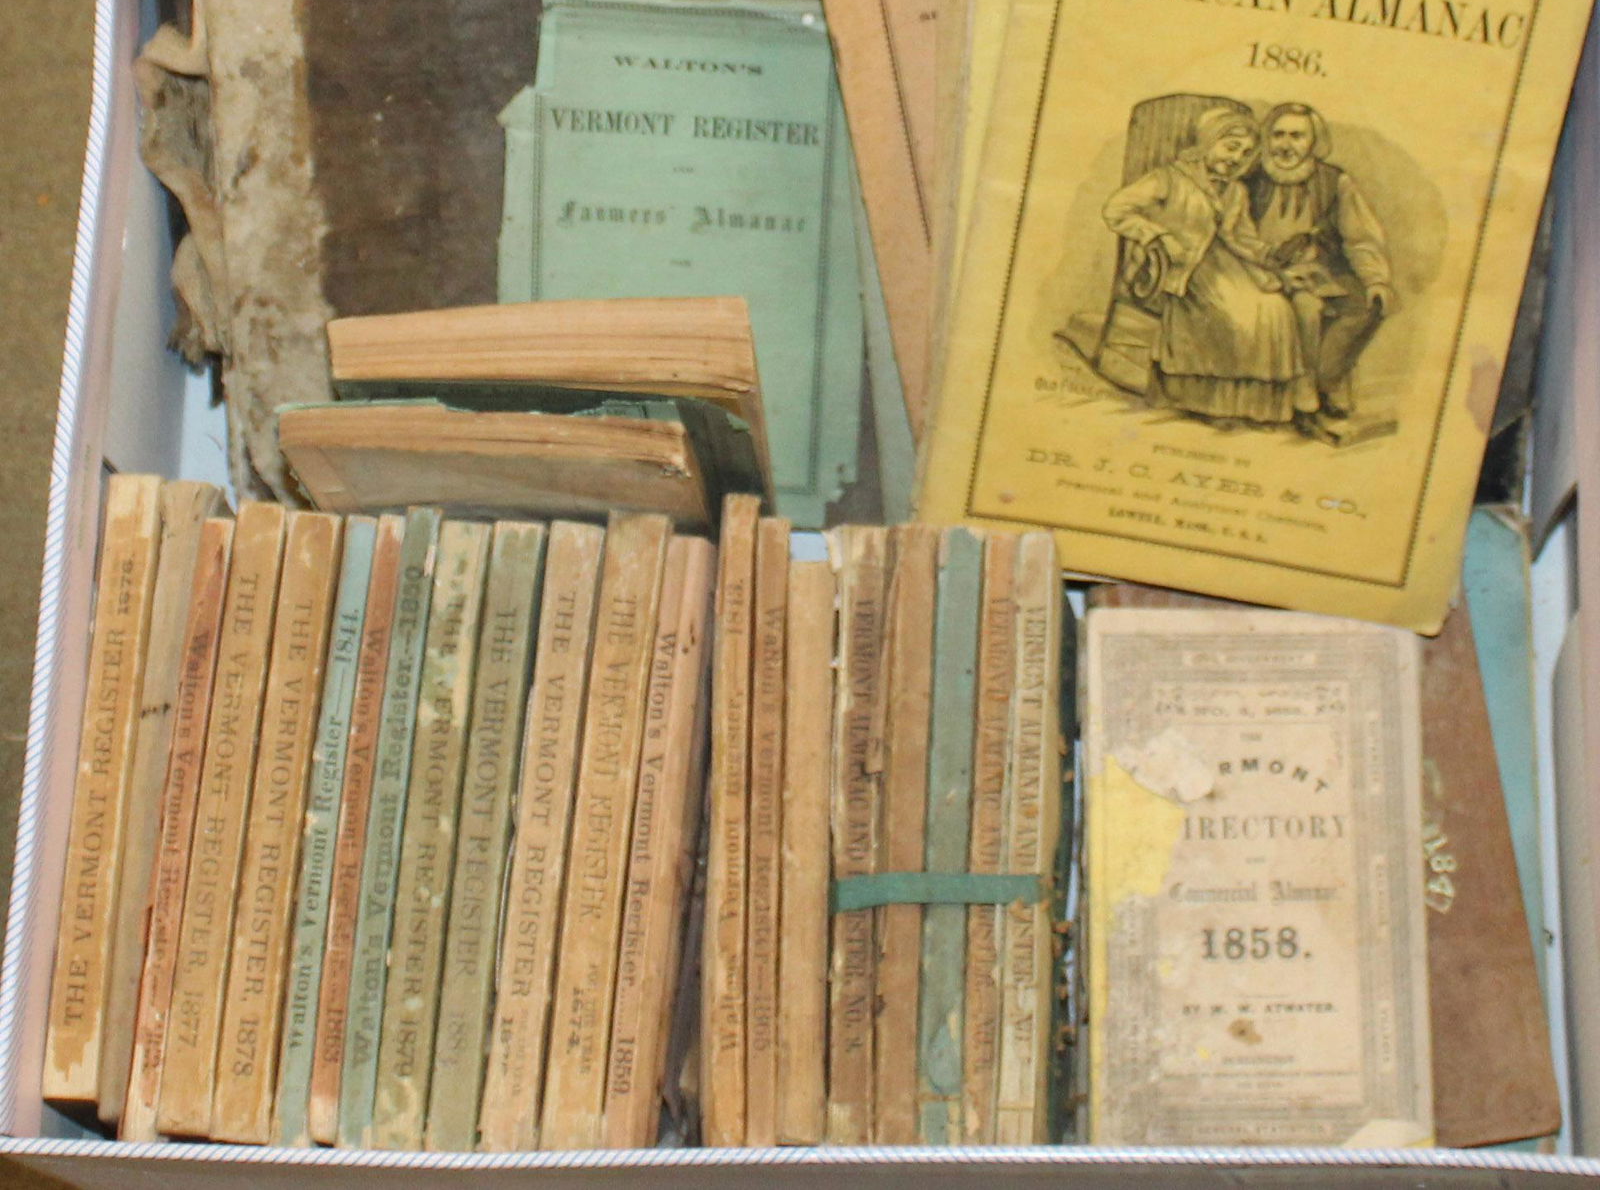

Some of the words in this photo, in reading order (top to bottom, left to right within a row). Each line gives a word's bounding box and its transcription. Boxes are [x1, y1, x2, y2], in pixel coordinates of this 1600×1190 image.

[614, 55, 763, 76] WALTON'S
[1246, 40, 1328, 78] 1886.
[551, 108, 676, 137] VERMONT
[693, 115, 820, 146] REGISTER
[1169, 472, 1264, 498] AYER
[1280, 489, 1301, 505] &
[233, 573, 259, 636] THE
[289, 598, 314, 660] THE
[439, 594, 468, 658] THE
[490, 608, 517, 665] THE
[551, 590, 577, 654] THE
[607, 595, 638, 647] THE
[852, 598, 877, 703] VERMONT
[92, 630, 125, 777] REGISTER
[647, 632, 678, 740] Walton's
[1021, 605, 1048, 709] VERMONT
[211, 650, 248, 800] VERMONT
[266, 676, 303, 827] VERMONT
[473, 678, 509, 817] VERMONT
[531, 674, 565, 826] VERMONT
[593, 660, 630, 779] VERMONT
[635, 753, 665, 863] Vermont
[1183, 814, 1347, 842] IRECTORY
[1218, 758, 1329, 794] RMONT
[72, 790, 107, 944] VERMONT
[364, 795, 398, 920] Vermont
[1016, 828, 1039, 867] AND
[239, 843, 281, 1002] REGISTER,
[288, 945, 313, 1051] Walton's
[302, 828, 329, 929] Vermont
[456, 834, 492, 978] REGISTER
[510, 843, 547, 998] REGISTER
[1201, 926, 1312, 961] 1858.
[64, 958, 89, 1027] THE
[350, 934, 383, 1069] Walton's
[232, 1017, 261, 1077] 1878
